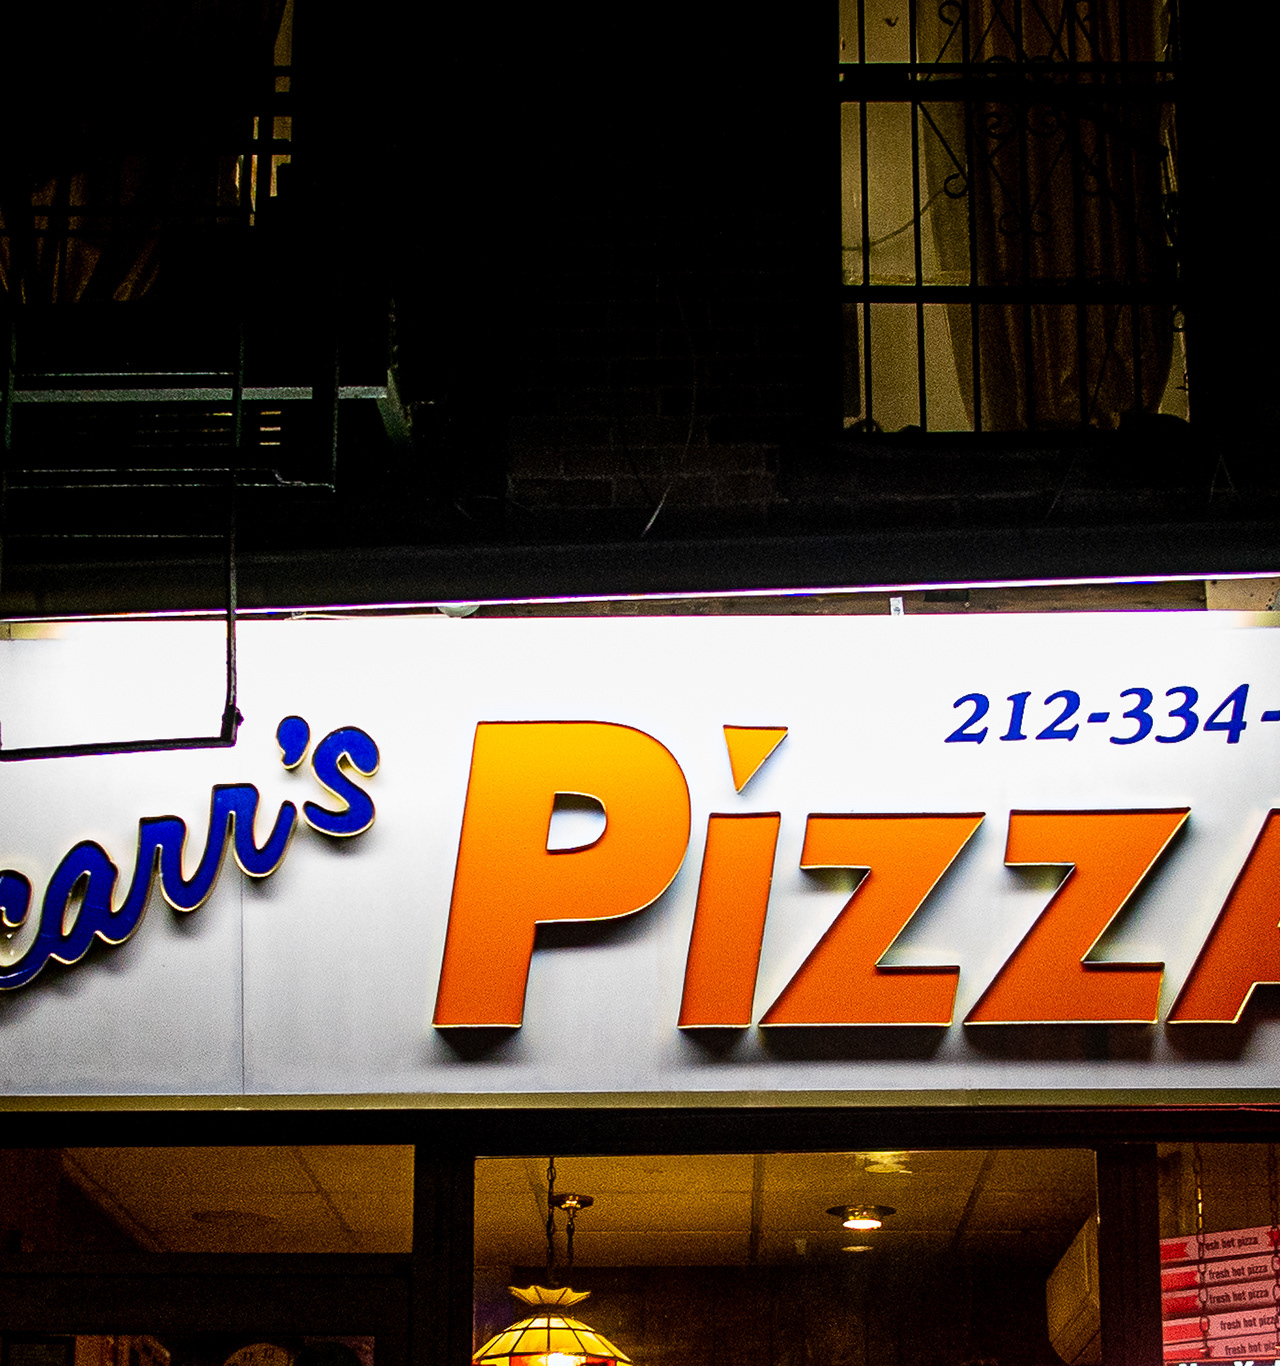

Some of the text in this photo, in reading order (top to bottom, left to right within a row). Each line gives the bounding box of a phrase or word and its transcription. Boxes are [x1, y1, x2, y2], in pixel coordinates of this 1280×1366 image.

[1237, 1236, 1258, 1247] pizza
[1209, 1268, 1230, 1280] fresh
[1247, 1264, 1268, 1276] pizza
[1209, 1292, 1231, 1304] fresh
[1248, 1289, 1269, 1300] pizza
[1220, 1319, 1241, 1331] fresh
[1225, 1344, 1247, 1356] fresh
